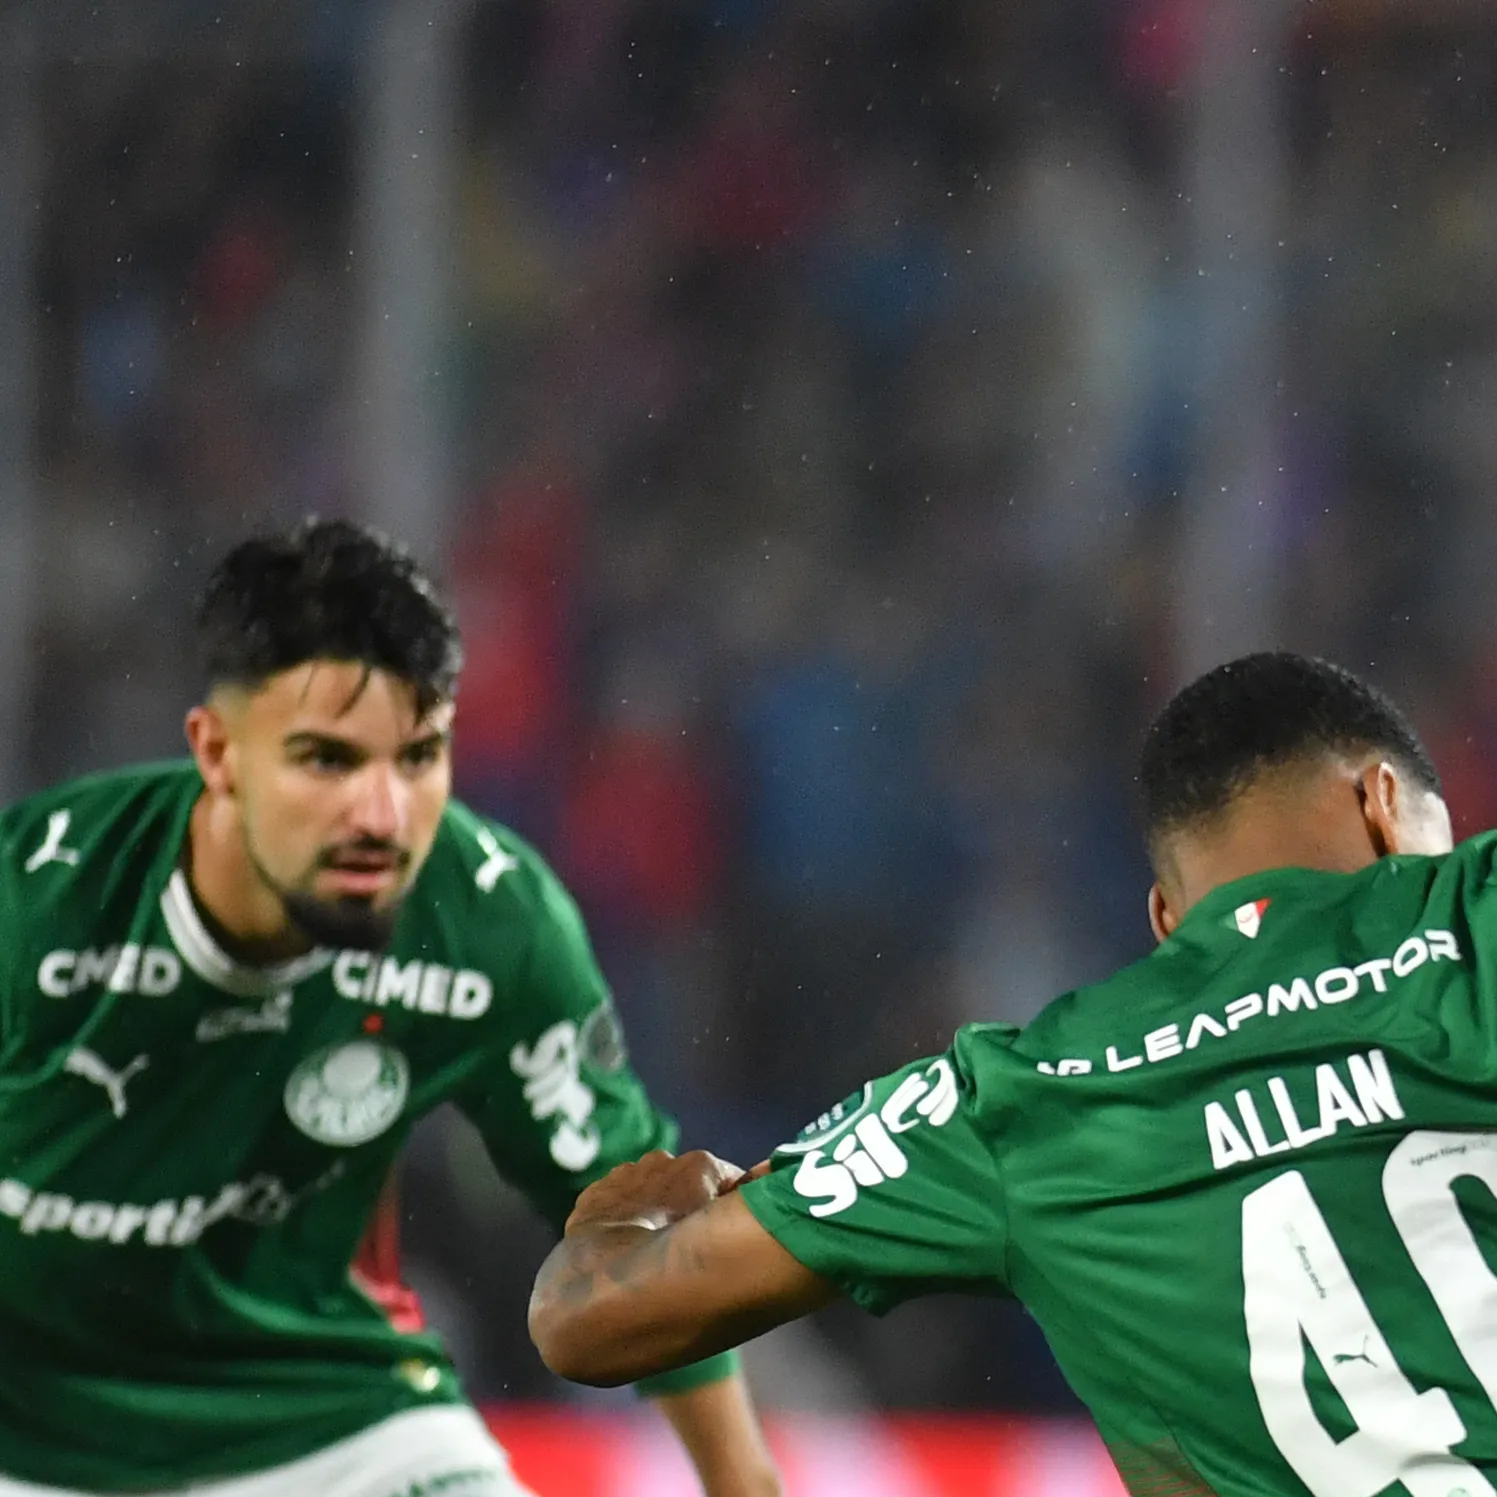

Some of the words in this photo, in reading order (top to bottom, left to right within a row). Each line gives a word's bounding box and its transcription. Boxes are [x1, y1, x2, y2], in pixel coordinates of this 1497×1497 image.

[332, 949, 494, 1020] CIMED
[1104, 928, 1463, 1073] LEAPMOTOR
[1204, 1048, 1406, 1170] ALLAN
